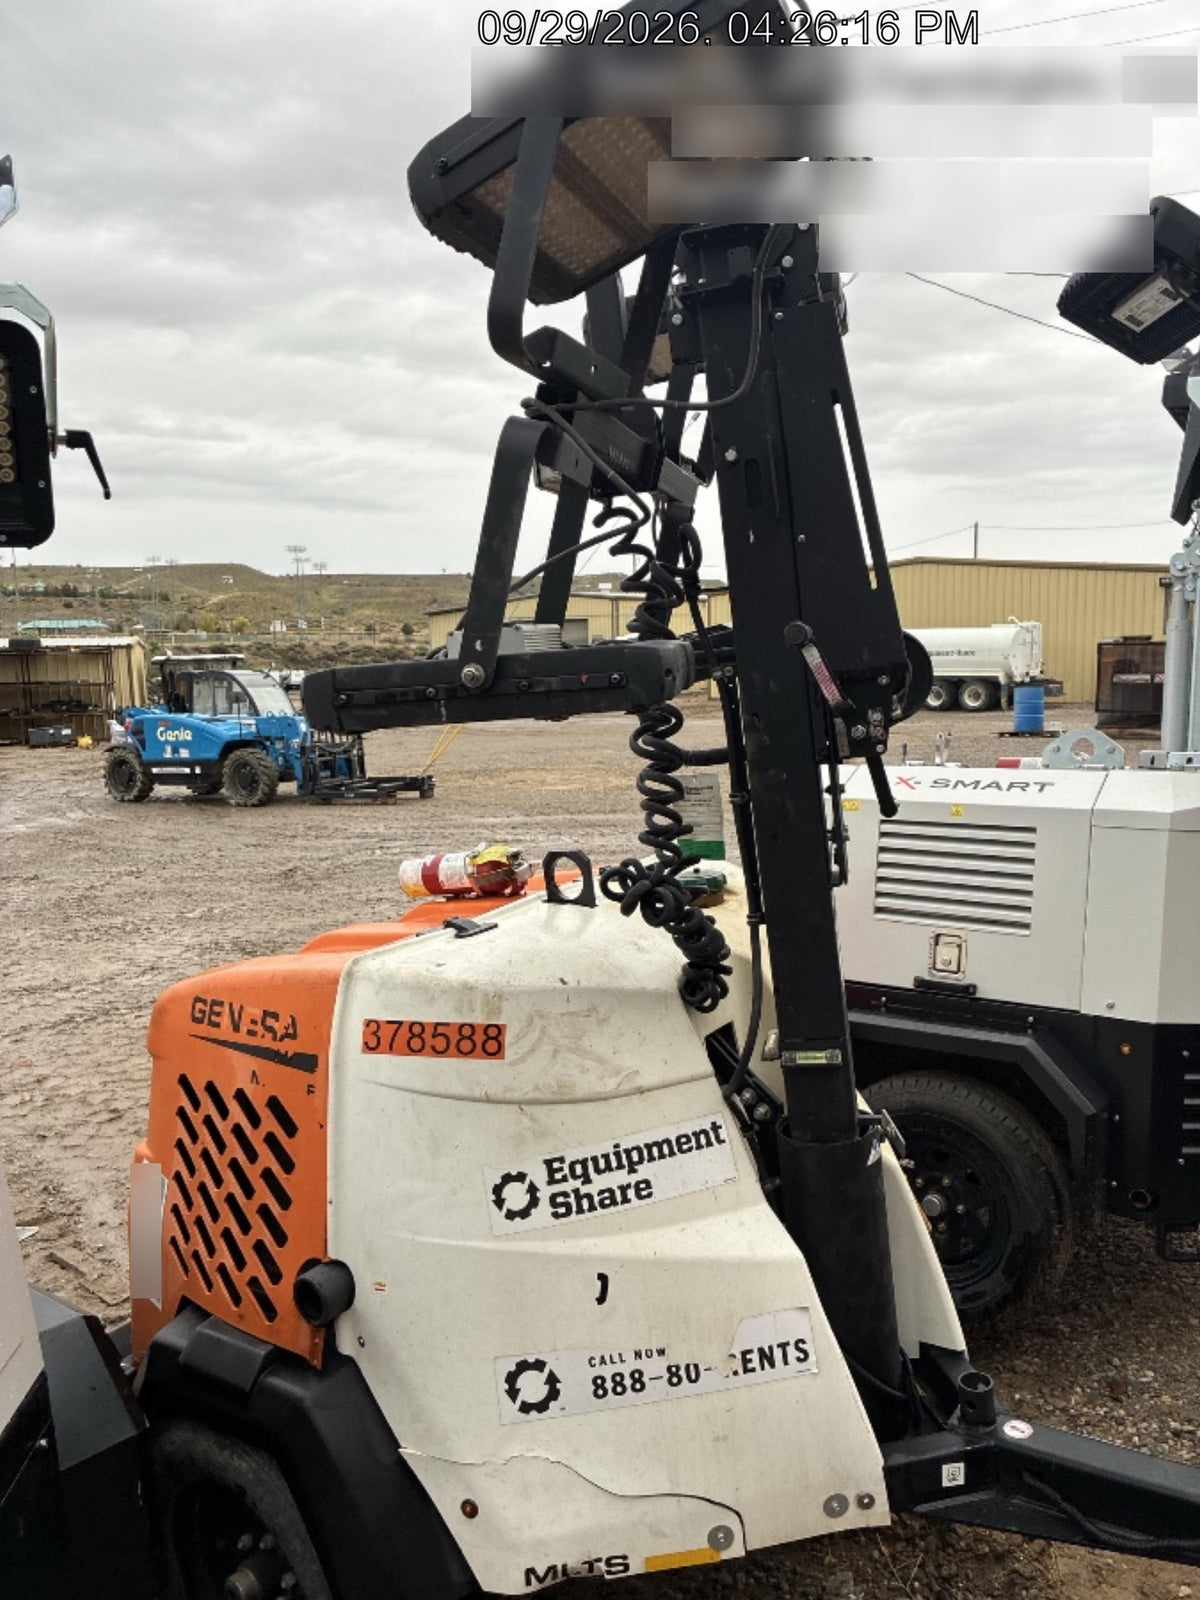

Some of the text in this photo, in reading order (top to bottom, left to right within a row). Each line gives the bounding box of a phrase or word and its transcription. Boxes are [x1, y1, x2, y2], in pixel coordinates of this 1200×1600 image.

[929, 778, 1055, 793] SMART
[364, 1020, 502, 1057] 378588
[543, 1120, 726, 1187] Equipment
[549, 1177, 653, 1220] Share
[588, 1347, 667, 1368] CALL NOW
